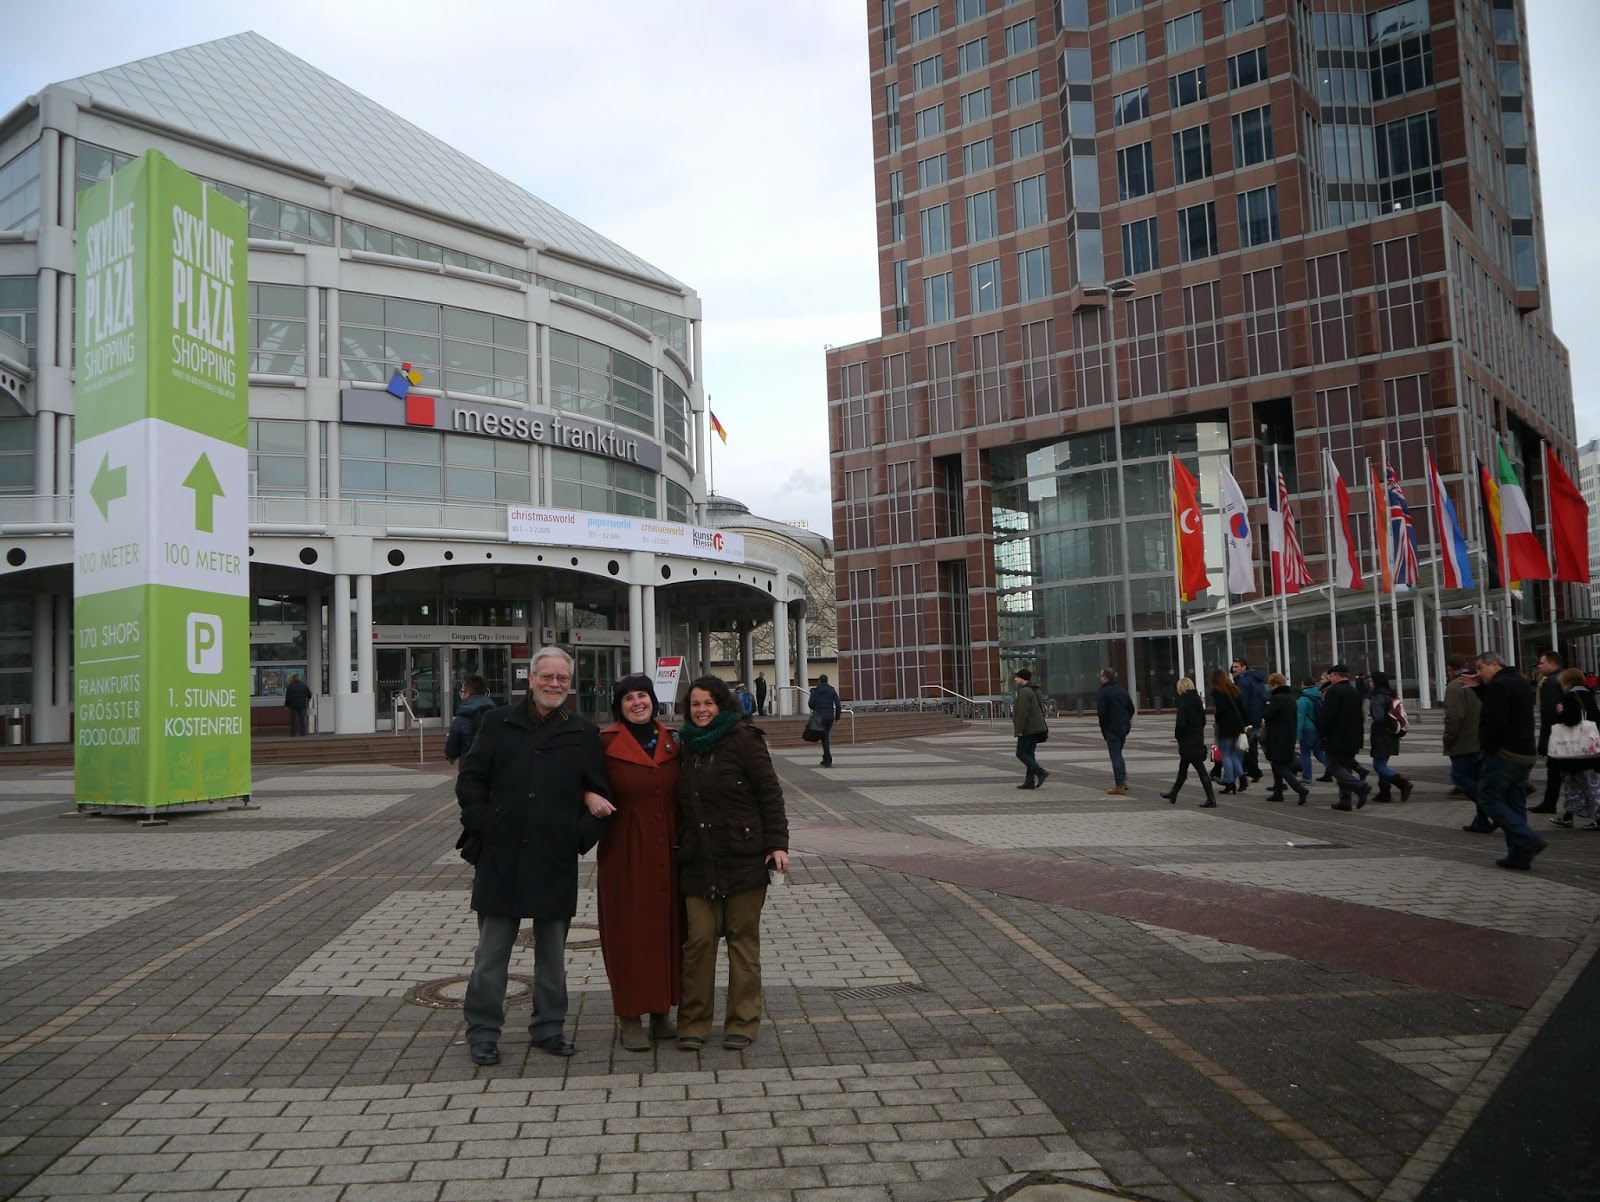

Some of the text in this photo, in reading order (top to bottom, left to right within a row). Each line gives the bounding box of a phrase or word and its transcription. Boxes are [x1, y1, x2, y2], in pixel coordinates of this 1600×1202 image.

[86, 190, 135, 276] SKYLINE
[172, 195, 235, 286] SKYLINE
[85, 257, 135, 348] PLAZA
[172, 257, 235, 355] PLAZA
[84, 332, 135, 381] SHOPPING
[172, 334, 236, 387] SHOPPING
[452, 405, 640, 463] messe frankfurt
[511, 509, 576, 524] christmasworld
[587, 517, 631, 530] paperworld
[641, 523, 685, 536] creativeworld
[692, 528, 714, 541] kunst
[100, 542, 140, 570] METER
[164, 541, 241, 575] 100 METER
[79, 620, 140, 649] 170 SHOPS
[194, 621, 215, 665] P
[452, 632, 477, 641] Eingang
[479, 633, 491, 641] City
[495, 633, 520, 641] Entrance
[79, 674, 141, 696] FRANKFURTS
[168, 687, 236, 708] 1. STUNDE
[80, 699, 141, 721] GRÖSSTER
[79, 726, 141, 746] FOOD COURT
[164, 716, 243, 737] KOSTENFREI
